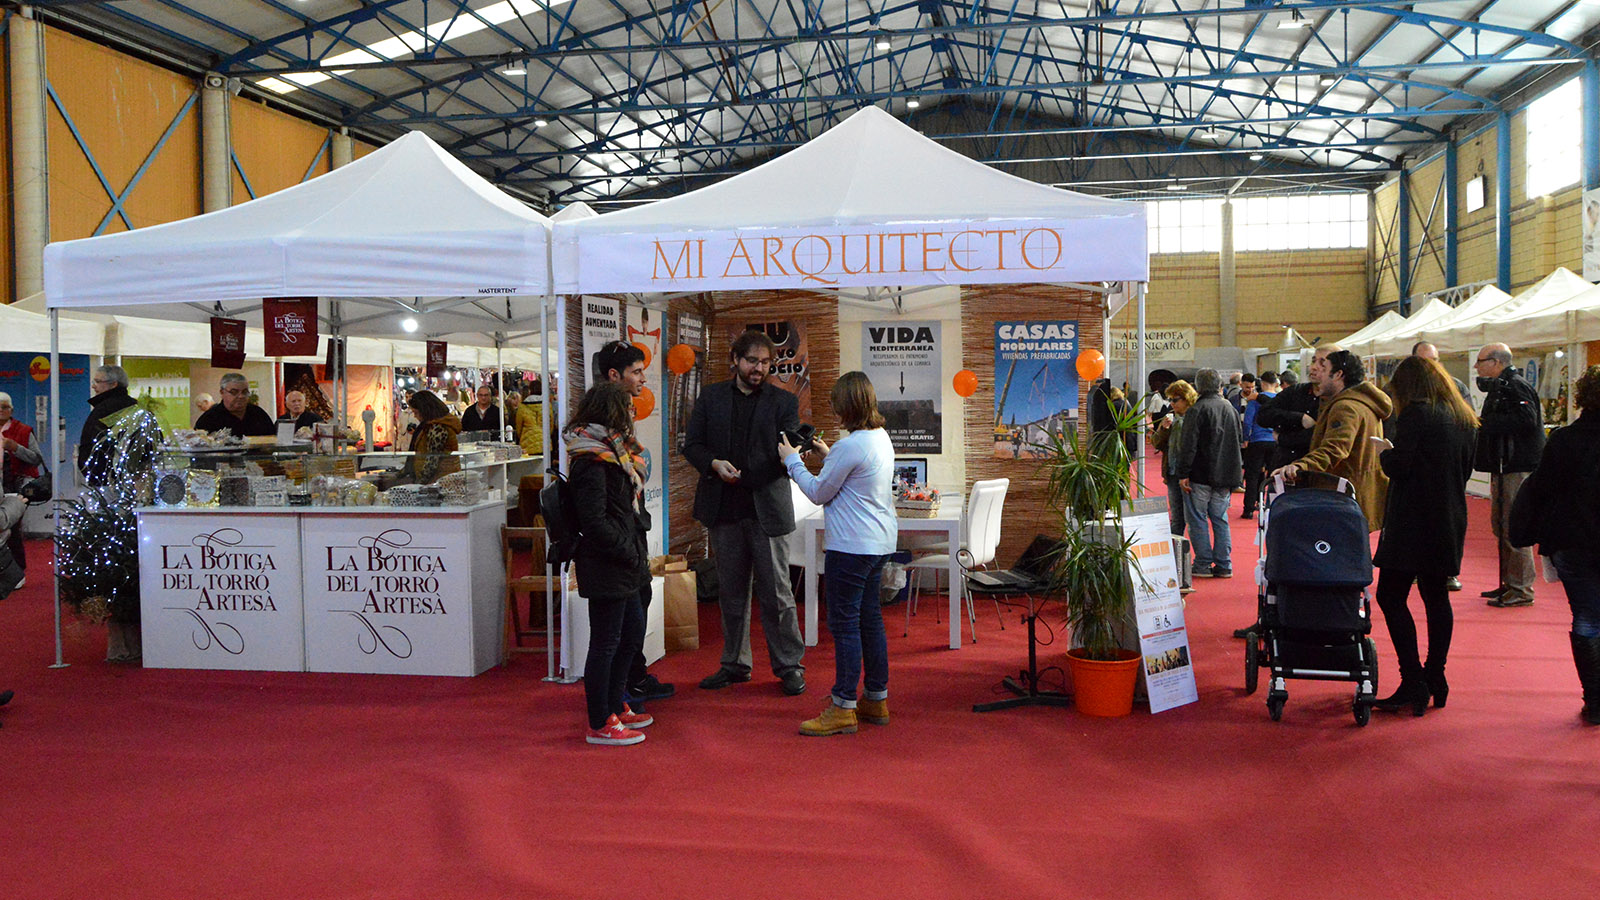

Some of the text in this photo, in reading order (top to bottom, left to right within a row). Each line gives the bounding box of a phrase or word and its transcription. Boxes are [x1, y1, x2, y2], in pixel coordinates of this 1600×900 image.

[651, 228, 1064, 285] MI ARQUITECTO
[587, 303, 614, 316] REALIDAD
[585, 317, 617, 329] AUMENTADA
[998, 324, 1076, 340] CASAS
[869, 327, 934, 343] VIDA
[1000, 342, 1073, 351] MODULARES
[1131, 339, 1190, 351] BNICARLÓ
[1002, 352, 1071, 360] VIVIENDAS PREFABRICADAS
[160, 545, 277, 571] LA BOTIGA
[325, 546, 447, 572] LA BOTIGA
[162, 569, 270, 591] DEL TORRÓ
[327, 572, 440, 593] DEL TORRÓ
[196, 587, 277, 611] ARTESÀ
[361, 589, 447, 614] ARTESÀ
